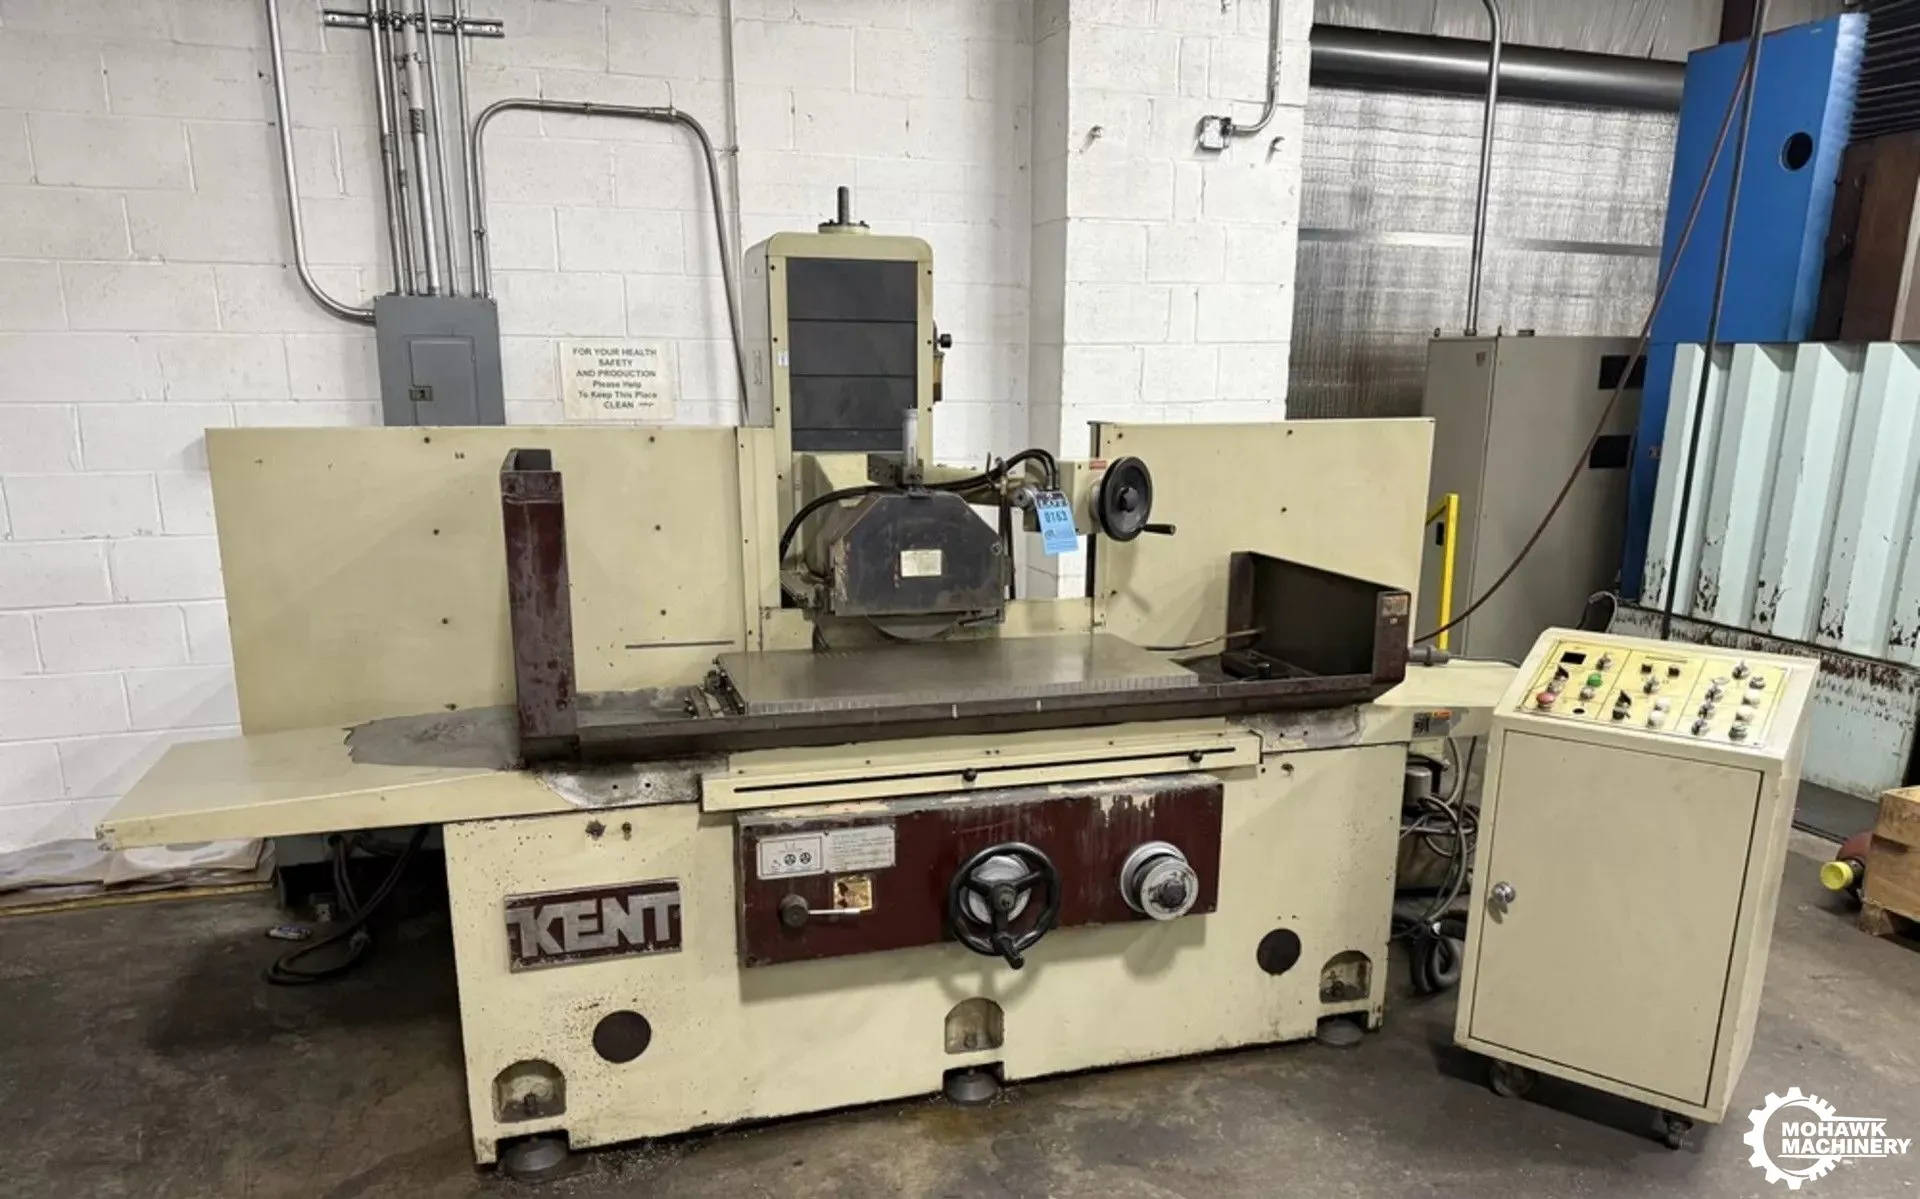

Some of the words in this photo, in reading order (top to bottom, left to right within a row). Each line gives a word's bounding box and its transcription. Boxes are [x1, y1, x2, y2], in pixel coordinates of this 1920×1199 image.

[572, 347, 592, 356] FOR
[594, 347, 620, 356] YOUR
[622, 348, 657, 356] HEALTH
[598, 369, 656, 377] PRODUCTION
[593, 380, 620, 388] Please
[578, 390, 589, 398] To
[591, 391, 613, 399] Keep
[615, 390, 633, 398] This
[603, 401, 634, 409] CLEAN
[506, 891, 680, 958] KENT
